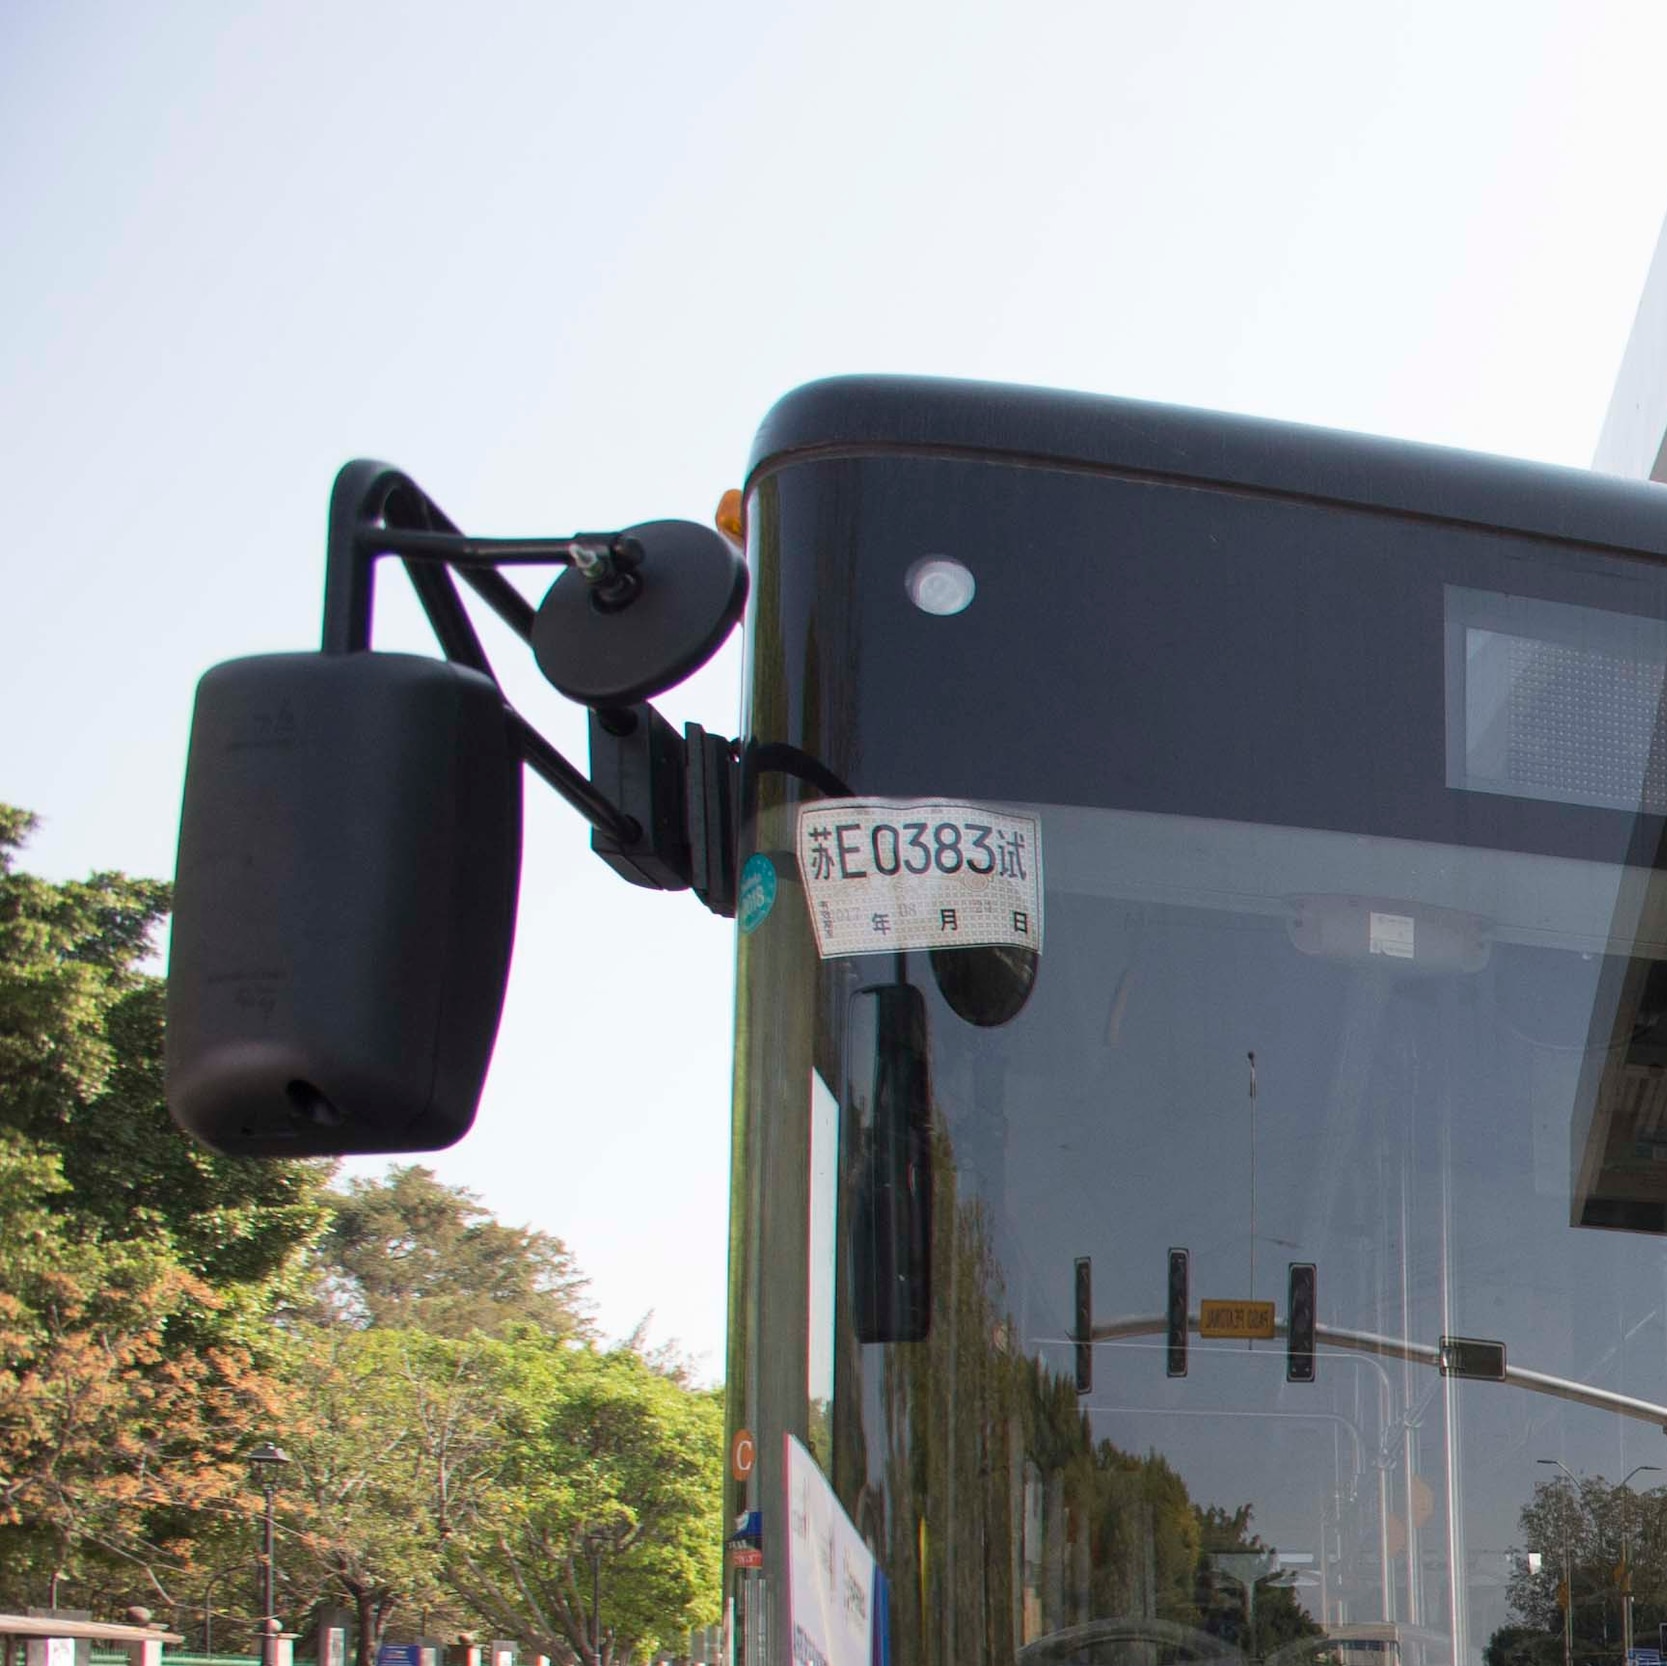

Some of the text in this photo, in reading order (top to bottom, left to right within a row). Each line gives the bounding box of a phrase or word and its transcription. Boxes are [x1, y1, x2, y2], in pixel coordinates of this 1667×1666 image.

[809, 822, 1027, 881] 苏E0383试
[872, 913, 891, 935] 年
[940, 908, 958, 931] 月
[1014, 911, 1028, 934] 日
[736, 1440, 752, 1471] C
